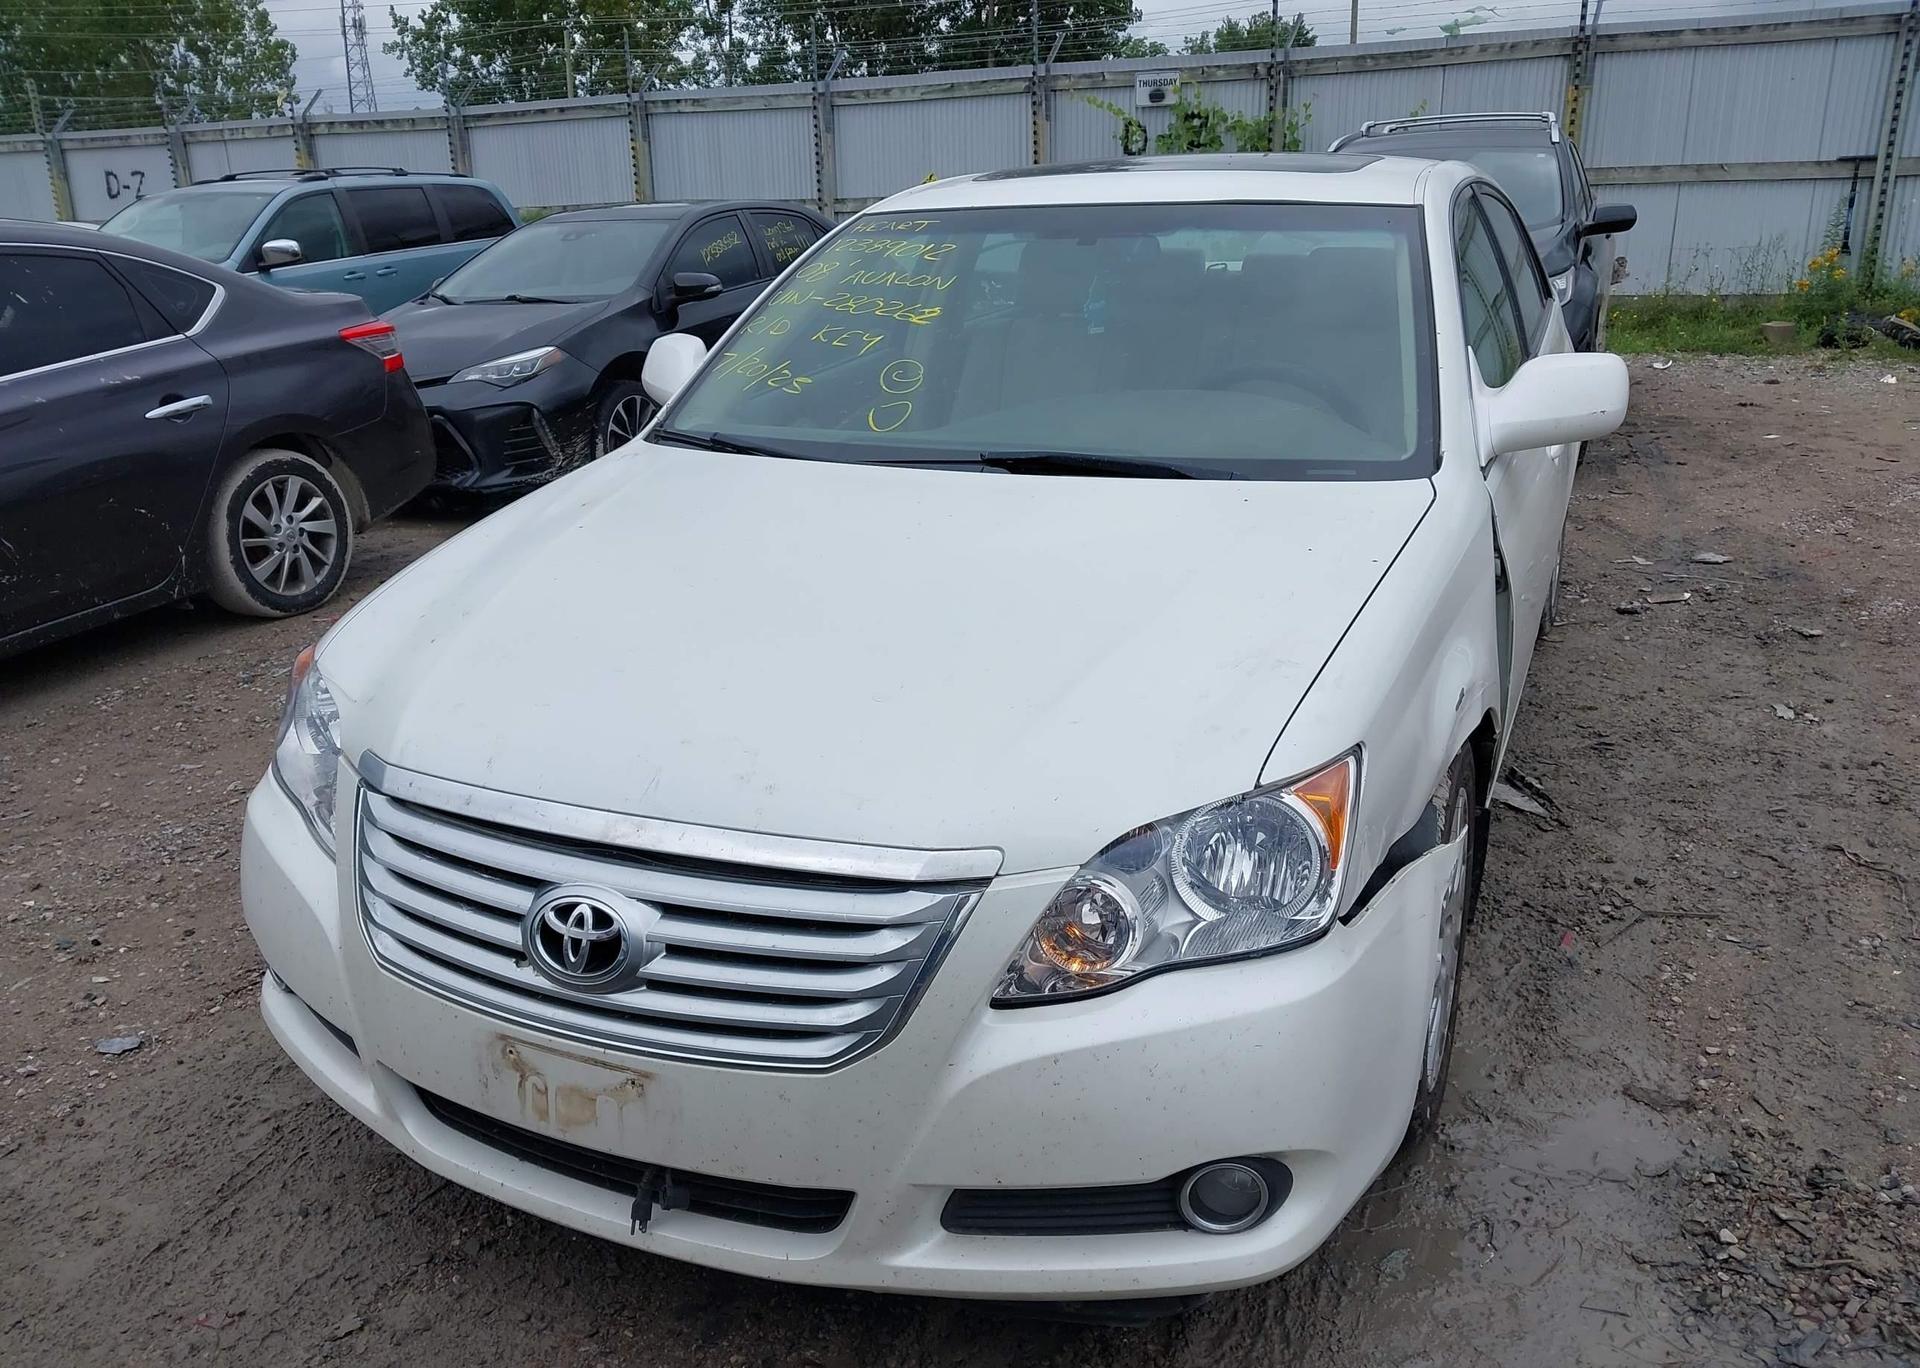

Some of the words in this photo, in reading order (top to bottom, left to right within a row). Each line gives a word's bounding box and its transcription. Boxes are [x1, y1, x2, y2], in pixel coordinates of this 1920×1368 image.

[1138, 77, 1178, 88] THURSDAY
[850, 220, 942, 234] HEART
[823, 238, 958, 261] 12389012
[839, 269, 957, 290] AVALON
[811, 323, 884, 356] KEY
